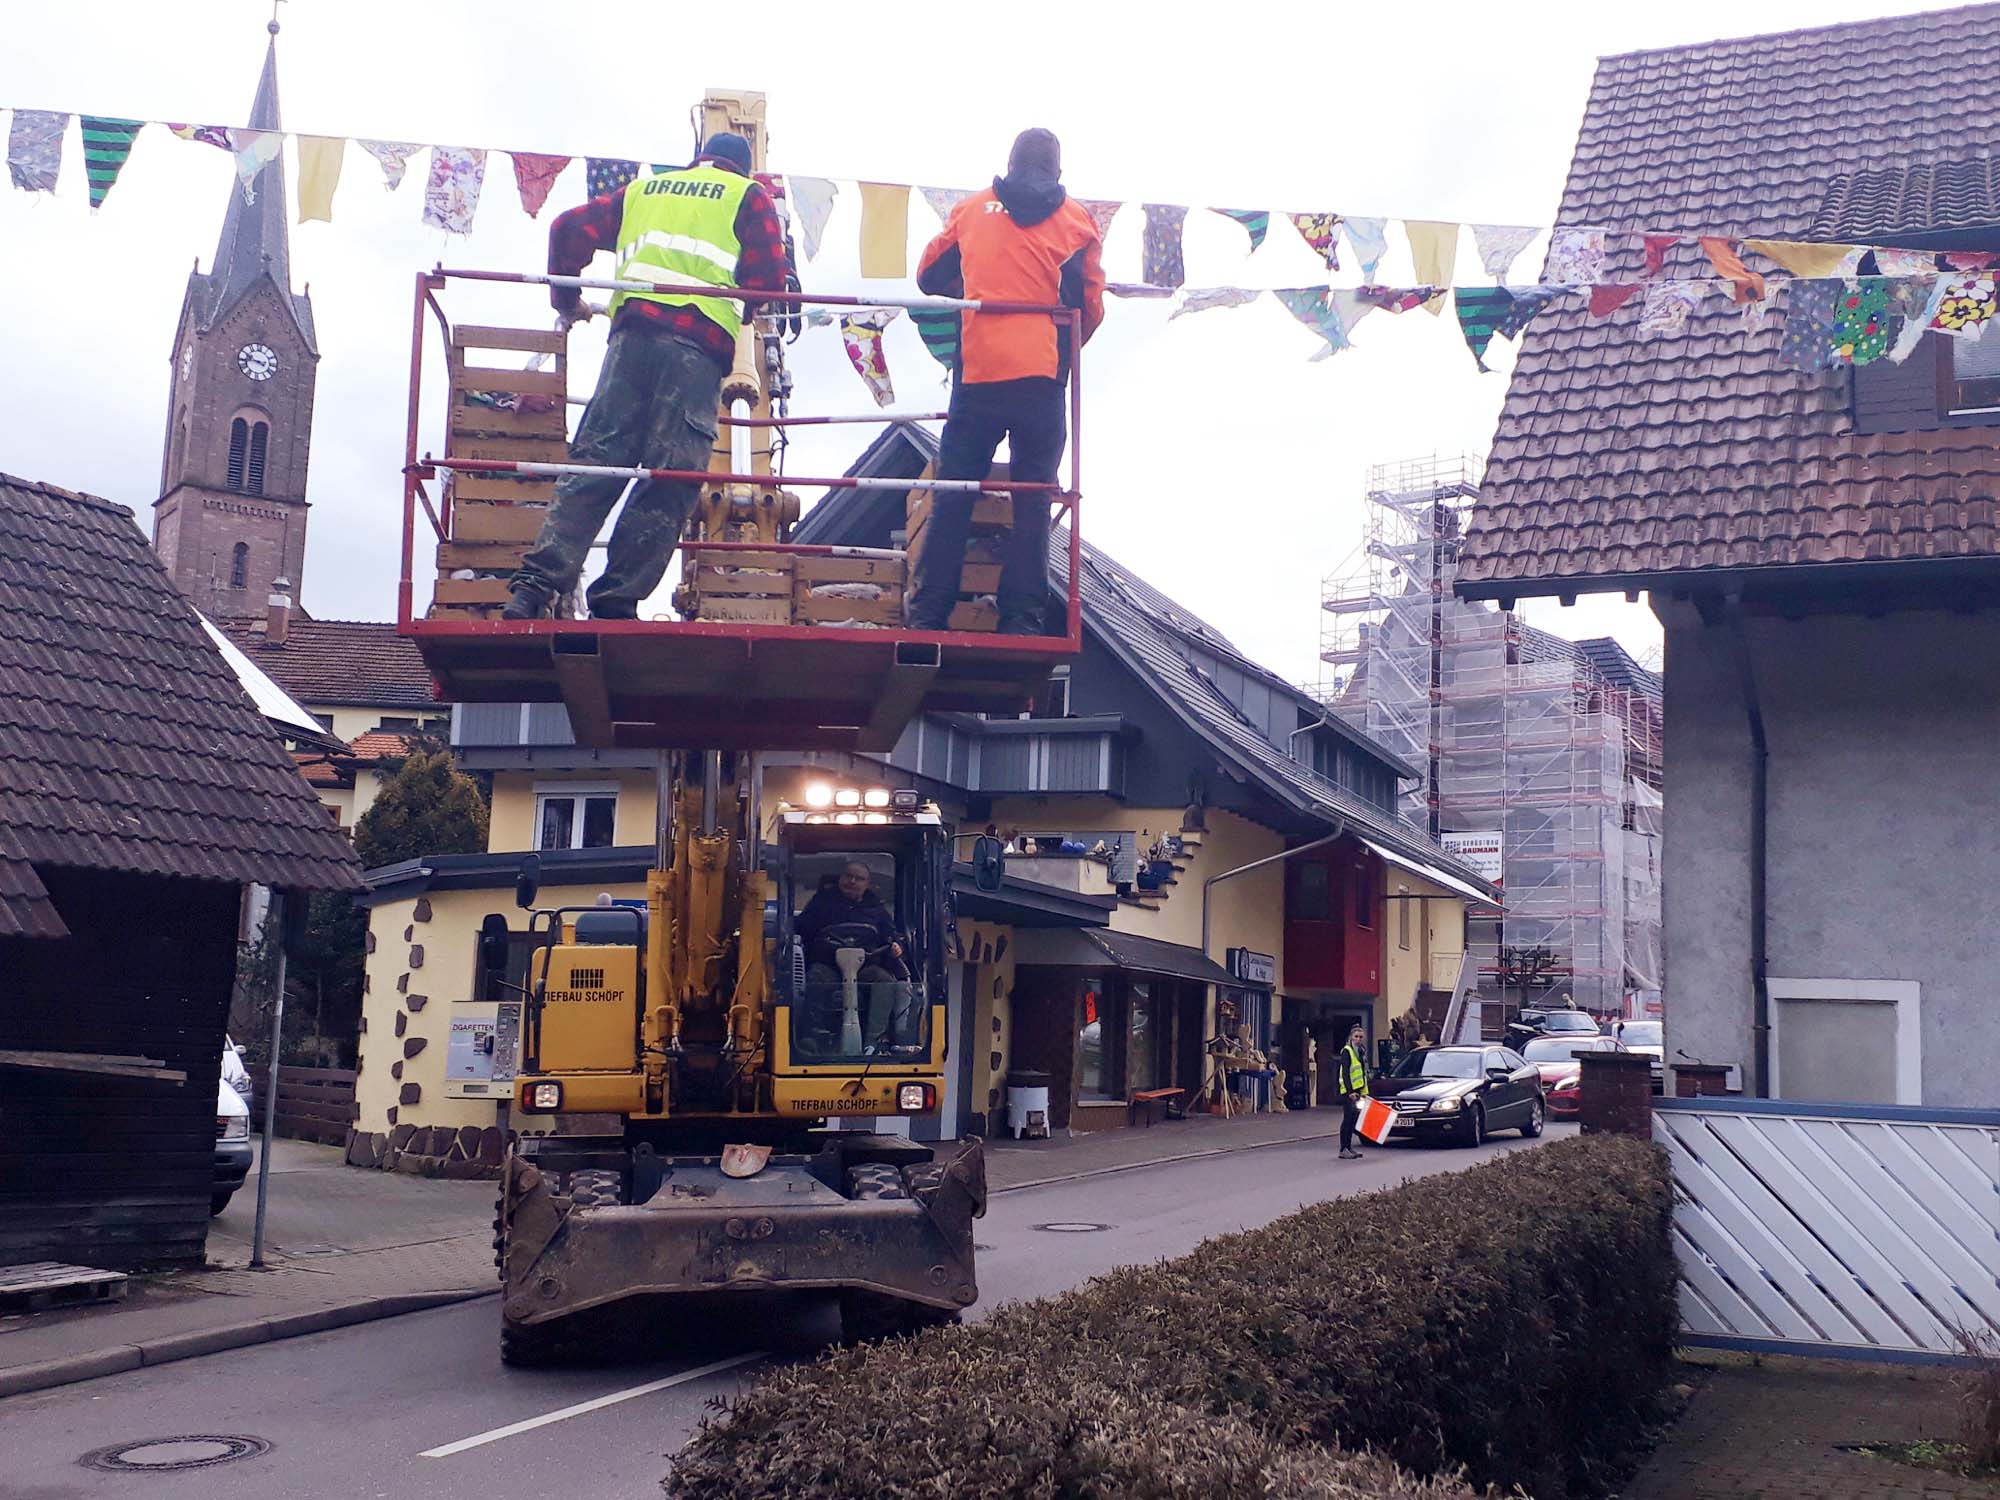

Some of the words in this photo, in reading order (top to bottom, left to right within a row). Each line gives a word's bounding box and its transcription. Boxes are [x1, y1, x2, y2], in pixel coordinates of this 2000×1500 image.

[643, 179, 726, 200] ORDNER
[791, 1100, 833, 1111] TIEFBAU
[837, 1098, 878, 1111] SCHÖPF
